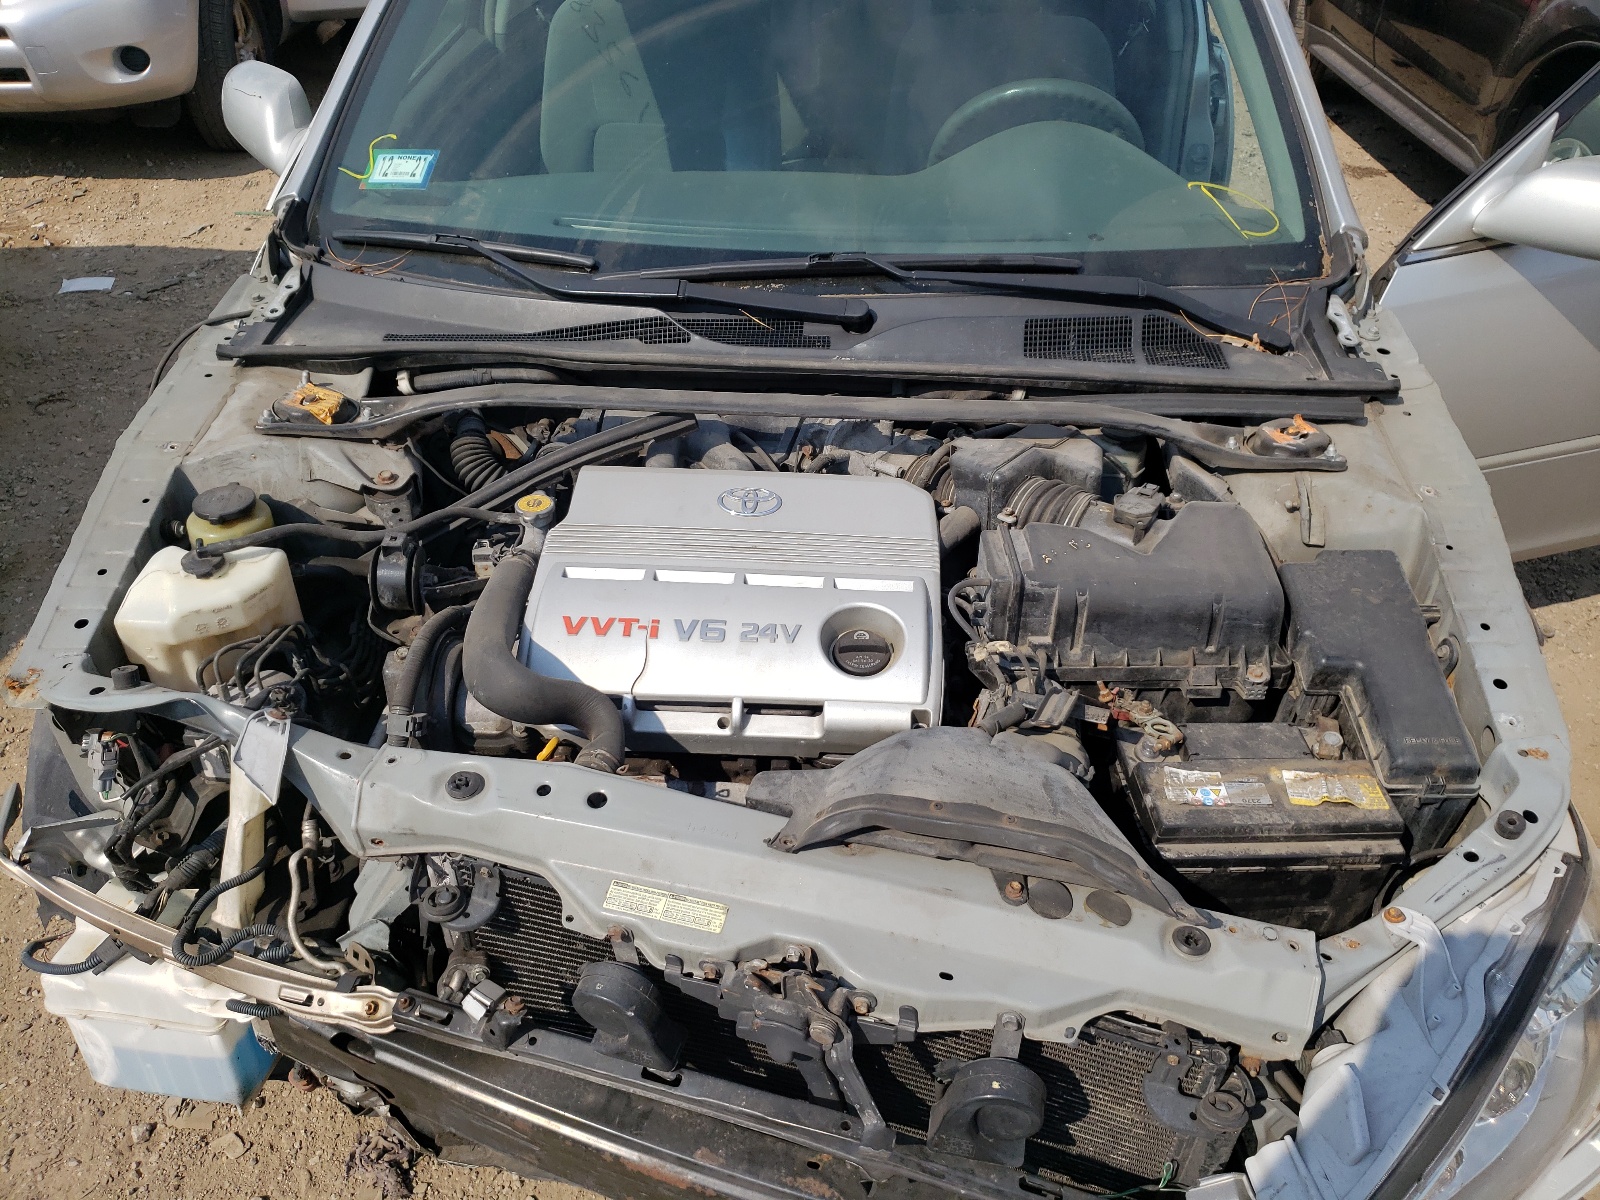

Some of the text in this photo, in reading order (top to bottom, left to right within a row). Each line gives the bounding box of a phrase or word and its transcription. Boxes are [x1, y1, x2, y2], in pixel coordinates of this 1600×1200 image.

[562, 615, 802, 644] VVT-i V6 24V
